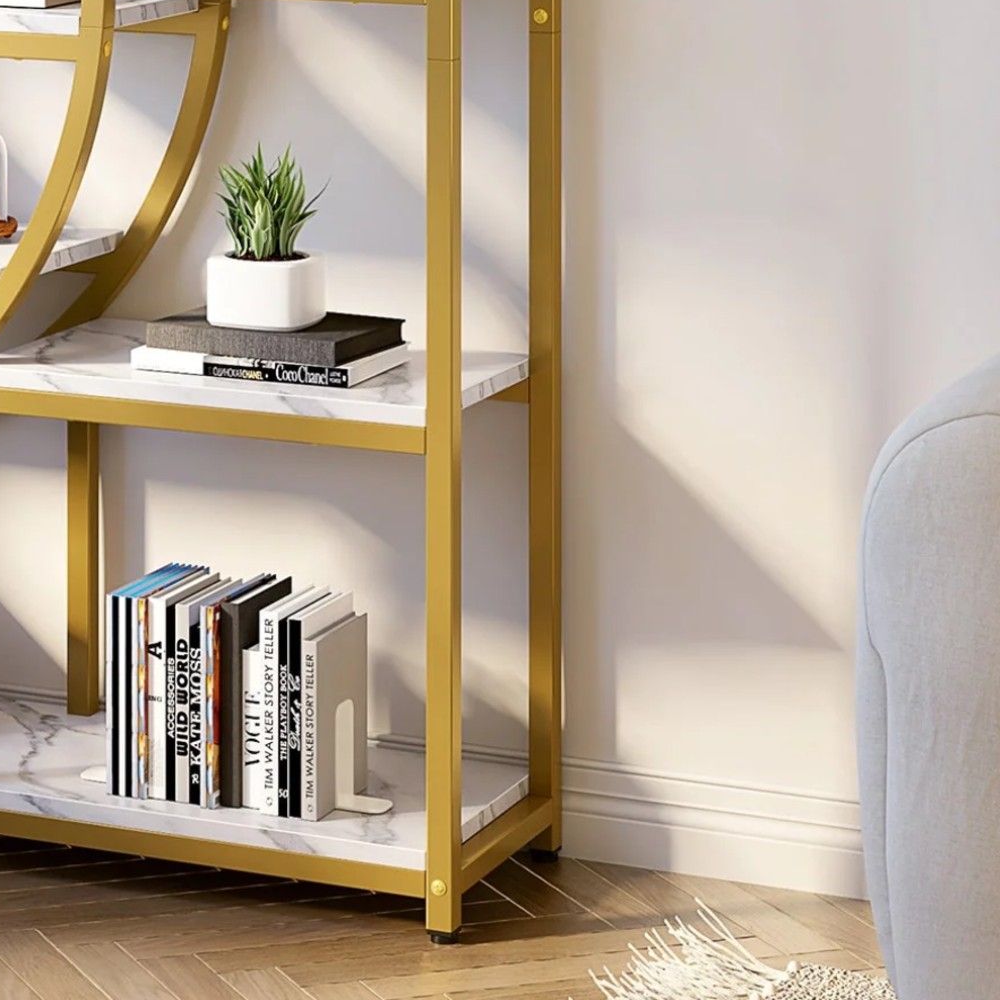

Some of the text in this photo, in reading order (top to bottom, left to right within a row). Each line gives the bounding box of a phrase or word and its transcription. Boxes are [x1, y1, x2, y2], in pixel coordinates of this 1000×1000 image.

[167, 657, 175, 739] ACCESSORIES
[177, 638, 188, 757] WILD WORLD
[190, 647, 201, 766] KATE MOSS
[244, 690, 260, 767] VOGUE
[264, 618, 274, 790] TIM WALKER STORY TELLER
[305, 654, 314, 798] TIM WALKER STORY TELLER
